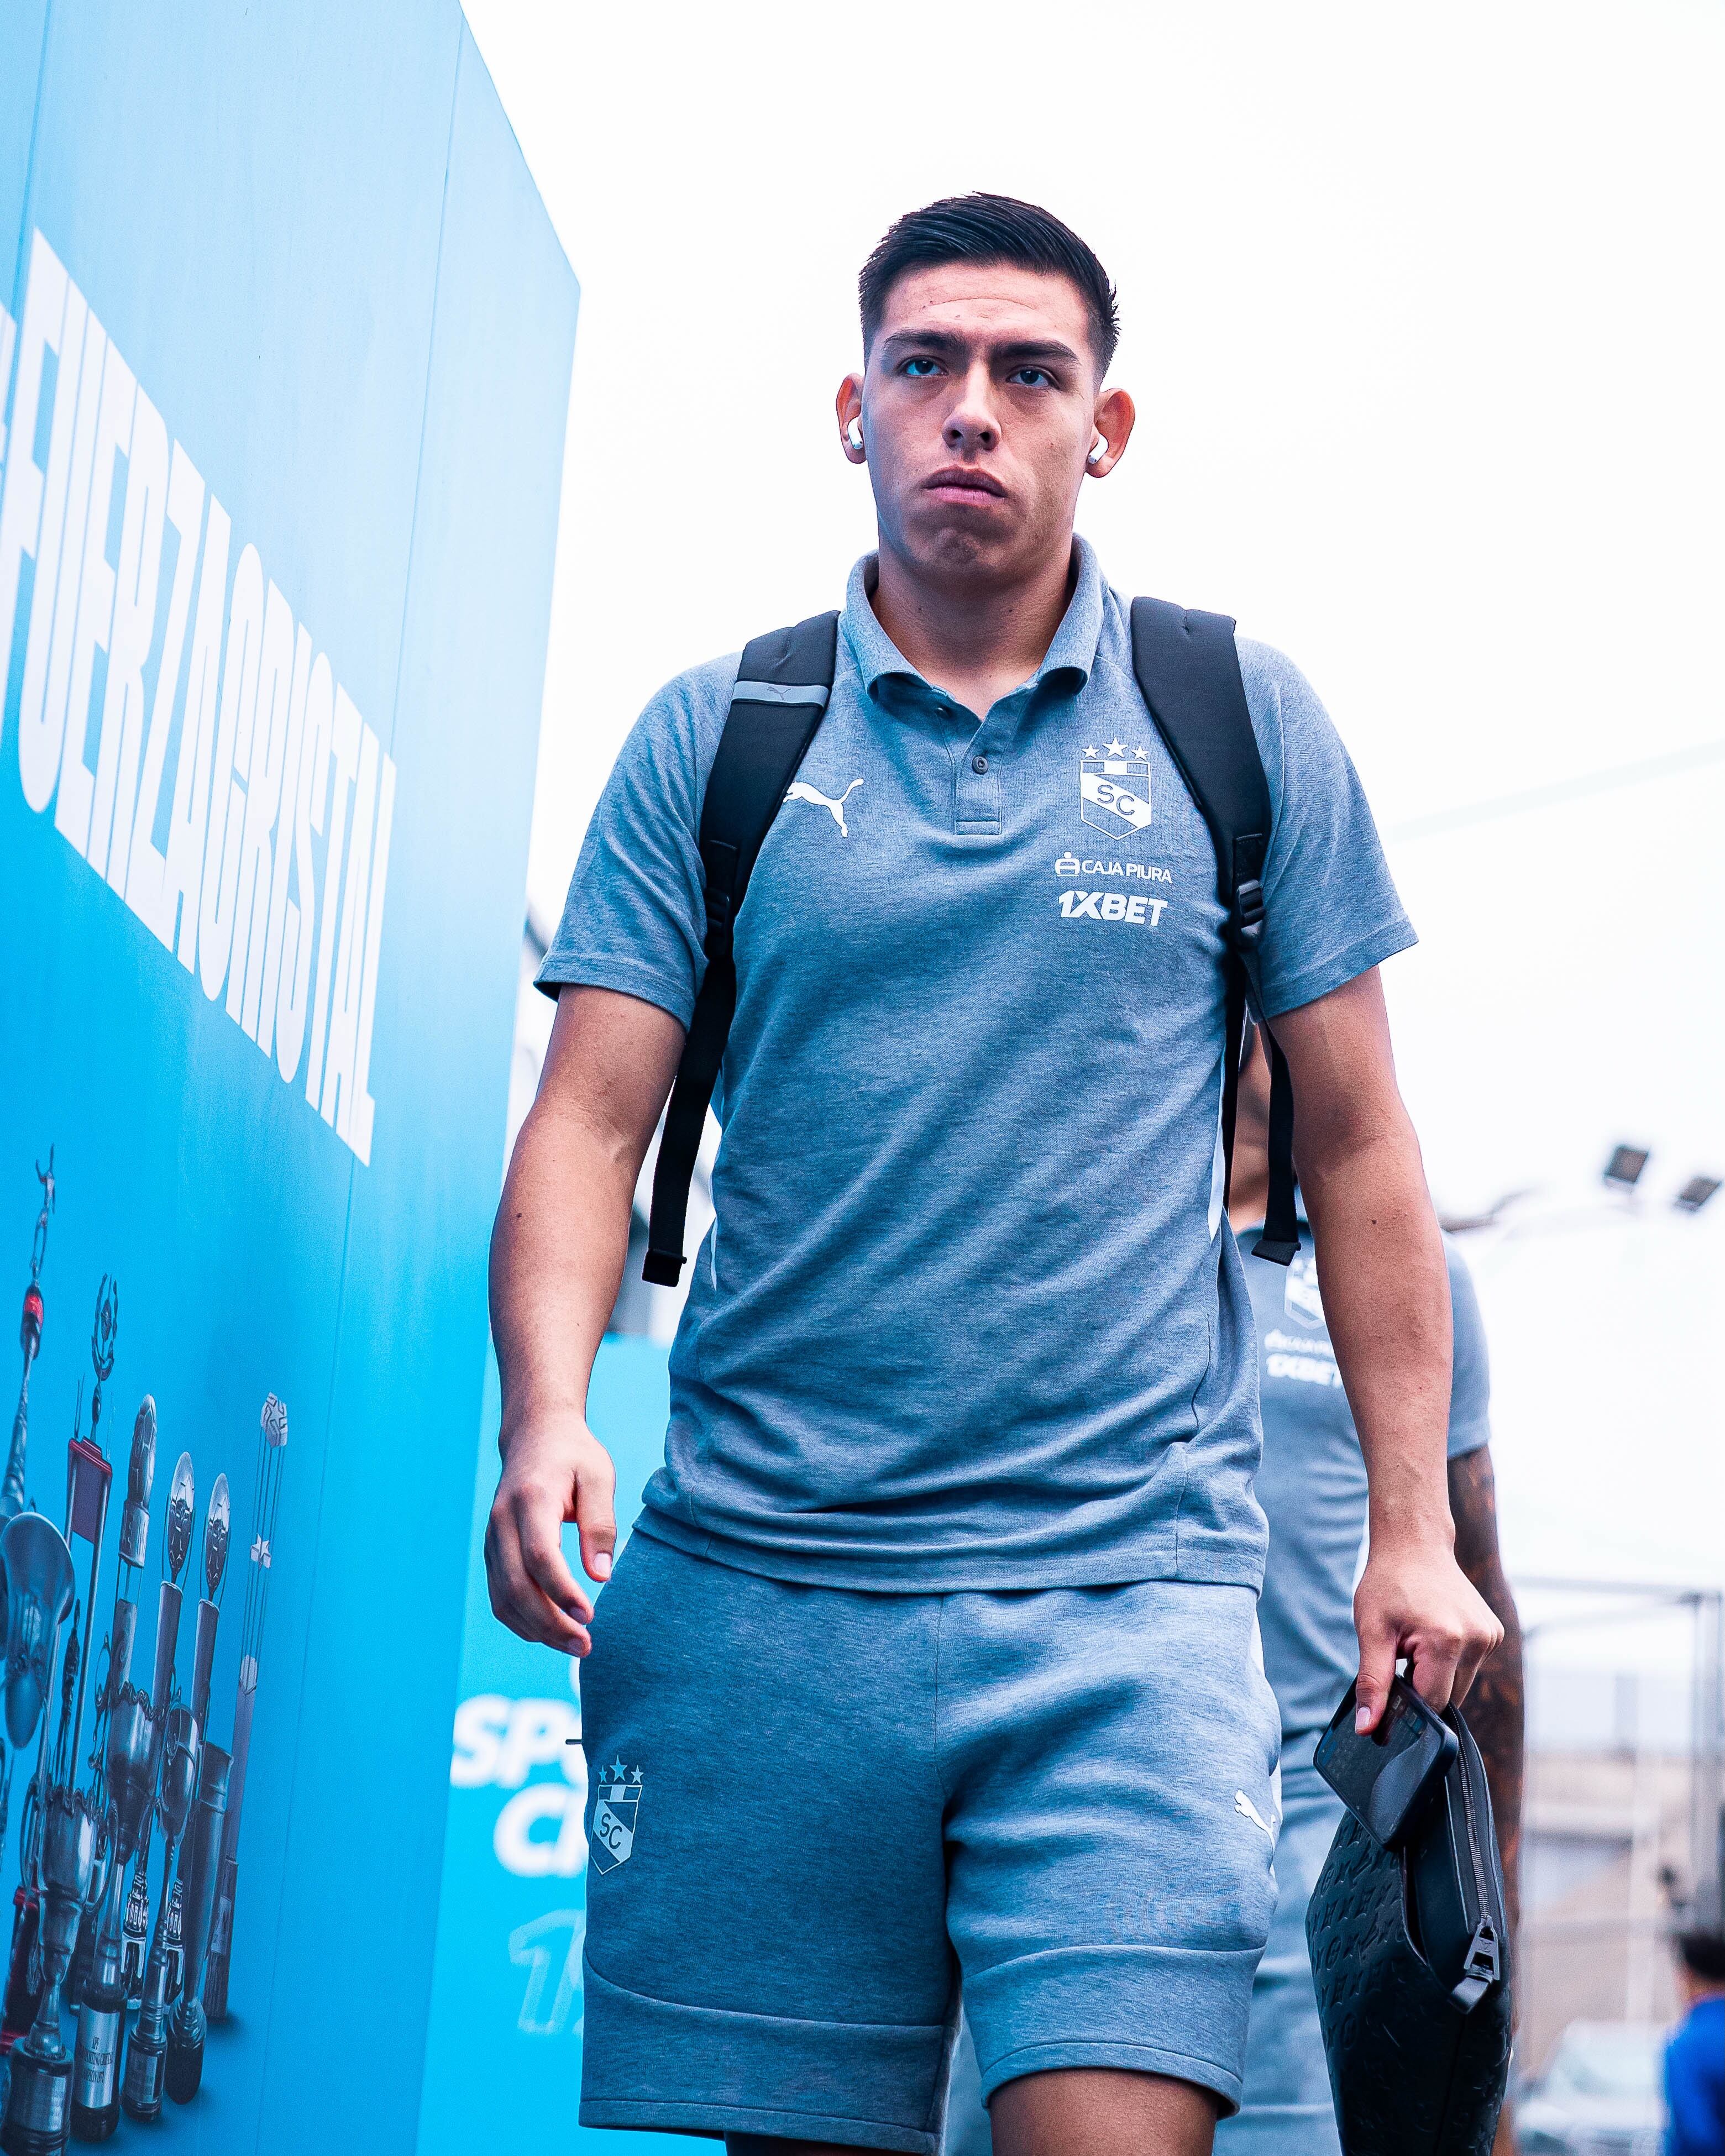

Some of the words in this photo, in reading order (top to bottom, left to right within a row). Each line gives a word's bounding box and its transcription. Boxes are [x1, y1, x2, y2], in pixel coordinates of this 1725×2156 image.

[1097, 784, 1135, 816] SC
[1082, 859, 1124, 877] CAJA
[1126, 863, 1173, 884] PIURA
[1058, 890, 1168, 927] 1XBET
[450, 1693, 588, 1790] SP
[599, 1813, 623, 1849] SC
